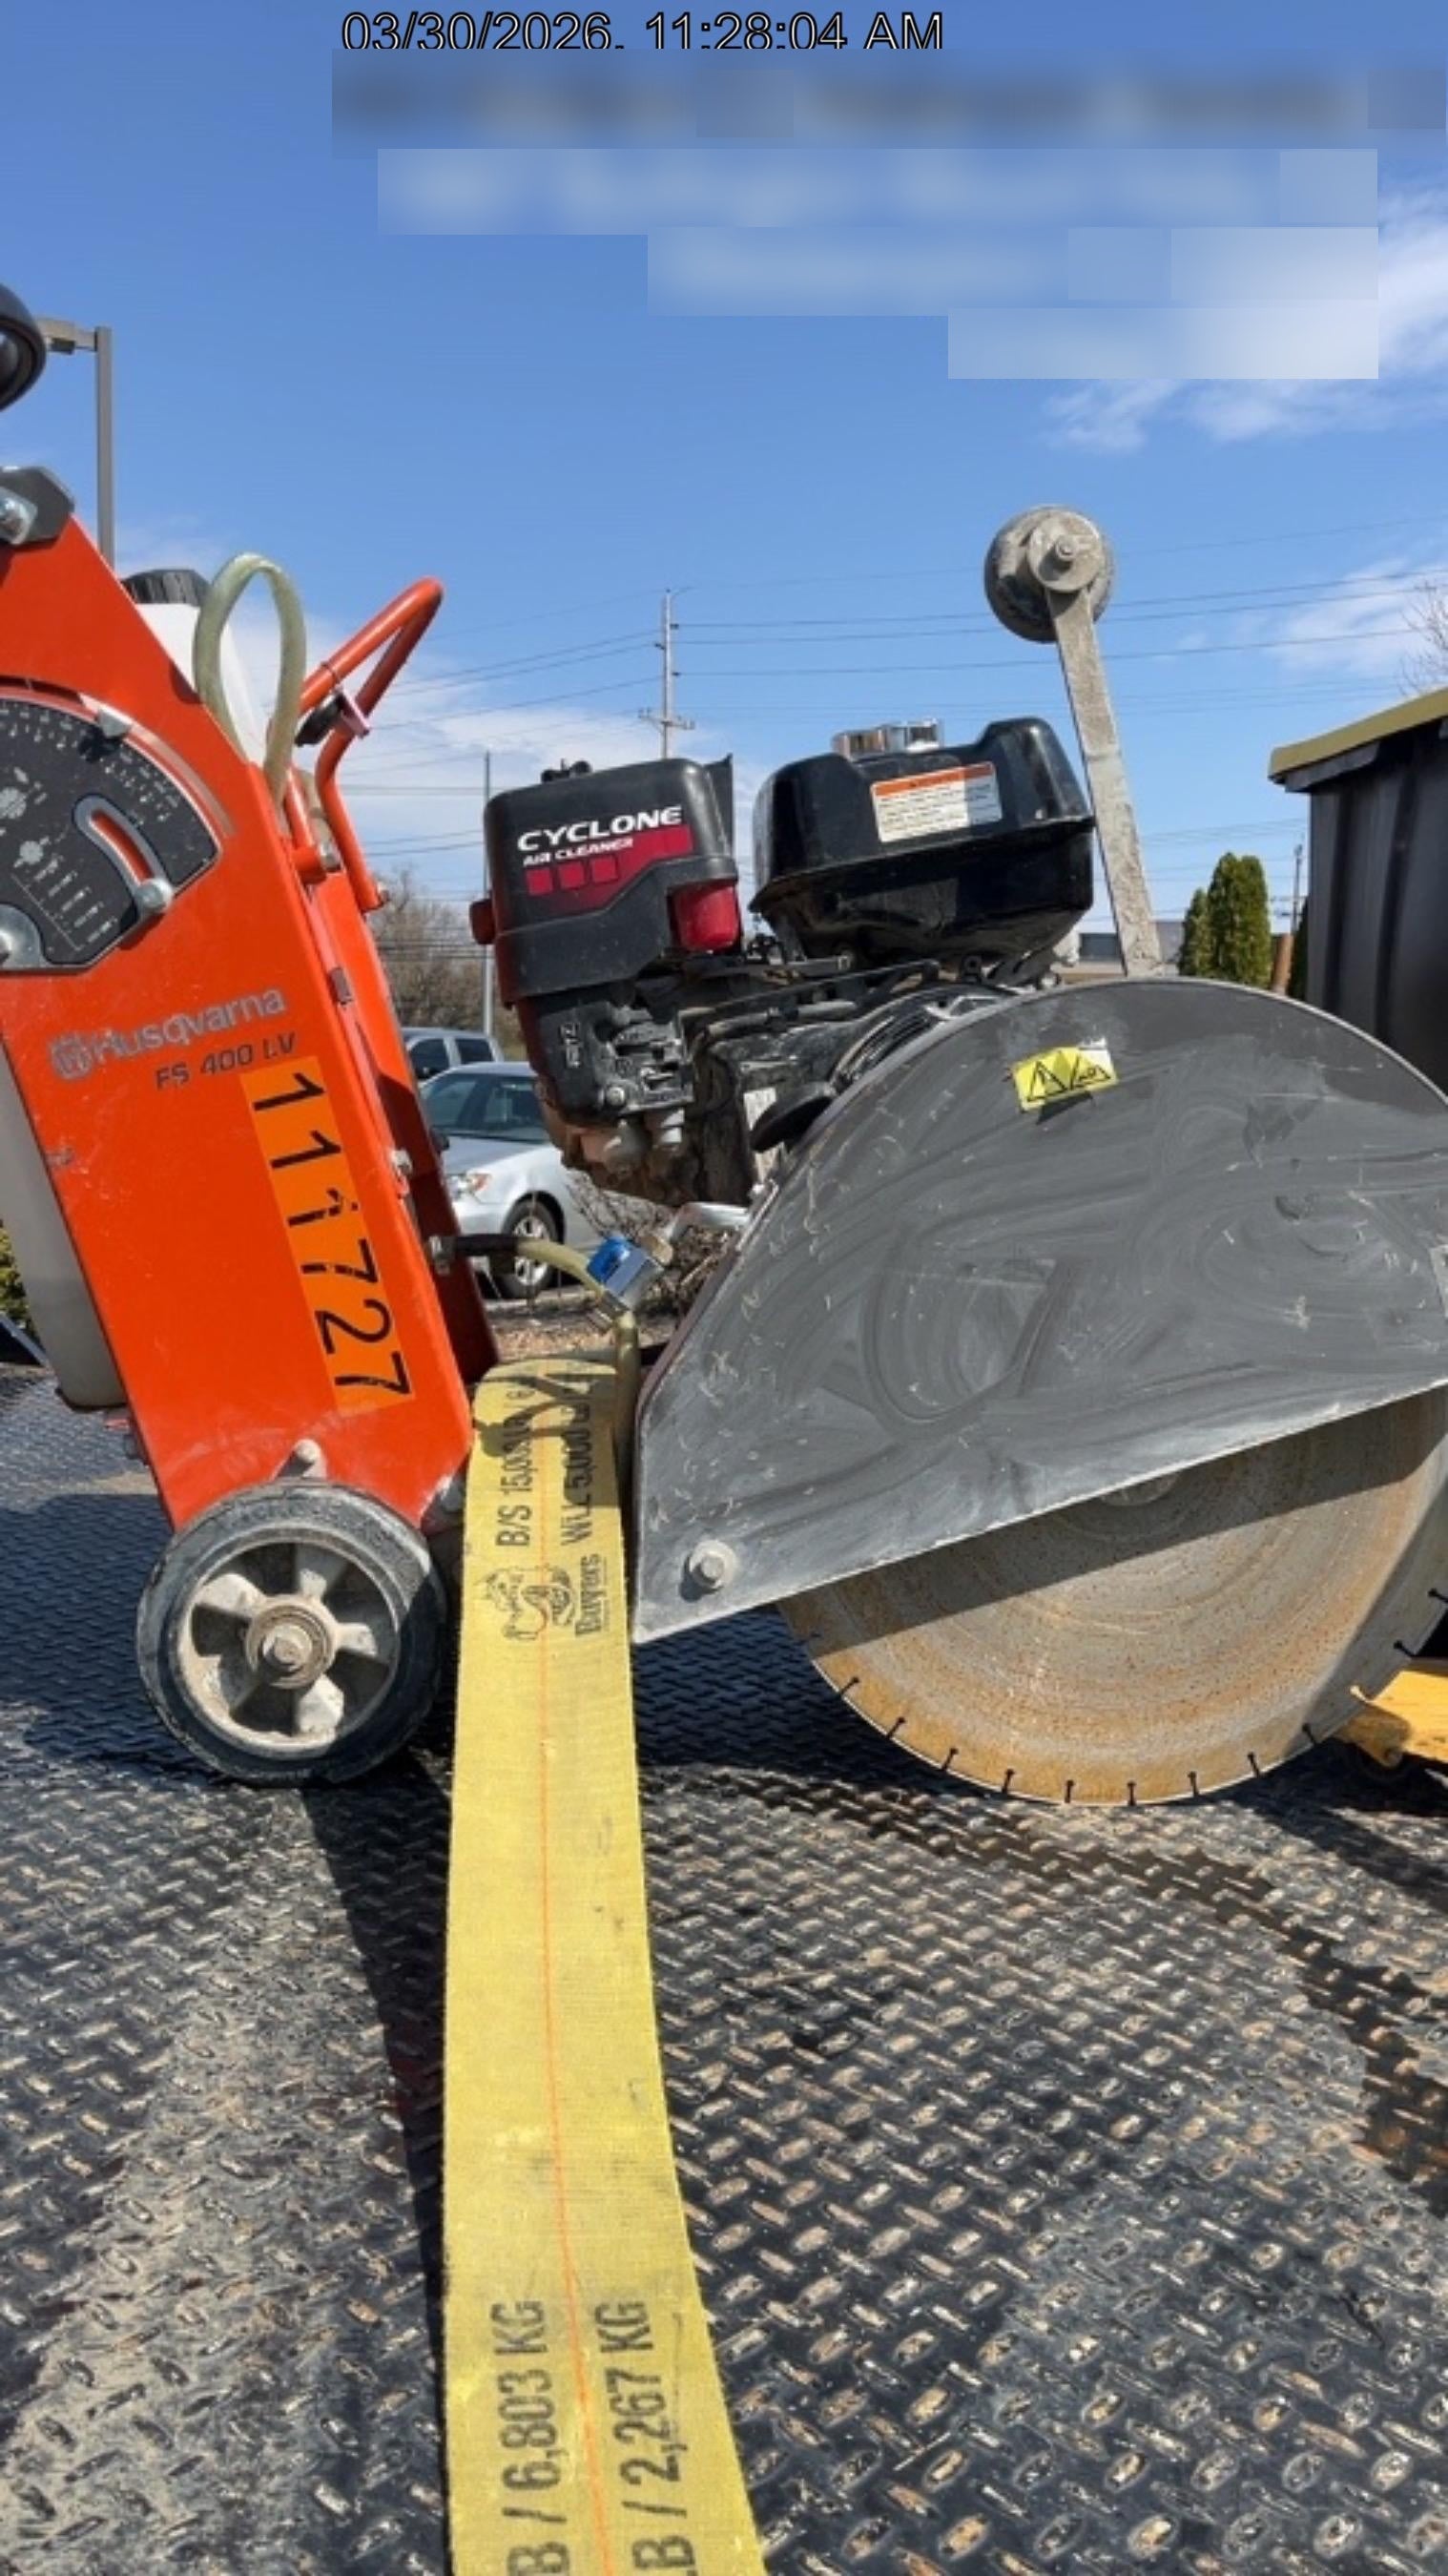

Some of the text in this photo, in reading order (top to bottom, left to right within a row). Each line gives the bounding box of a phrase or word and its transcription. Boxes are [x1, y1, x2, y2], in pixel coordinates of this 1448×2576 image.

[518, 805, 682, 851] CYCLONE
[523, 838, 633, 866] AIR CLEANER
[93, 989, 285, 1063] Husqvarna
[155, 1062, 190, 1090] FS
[199, 1045, 254, 1074] 400
[254, 1072, 411, 1396] 111727
[496, 1505, 531, 1546] B/S
[560, 1493, 592, 1546] WLL
[575, 1553, 603, 1637] Buyers
[490, 2301, 548, 2356] KG
[594, 2300, 654, 2354] KG
[497, 2369, 569, 2490] 6,803
[605, 2367, 689, 2485] 2,267
[502, 2505, 568, 2524] /
[622, 2500, 688, 2519] /
